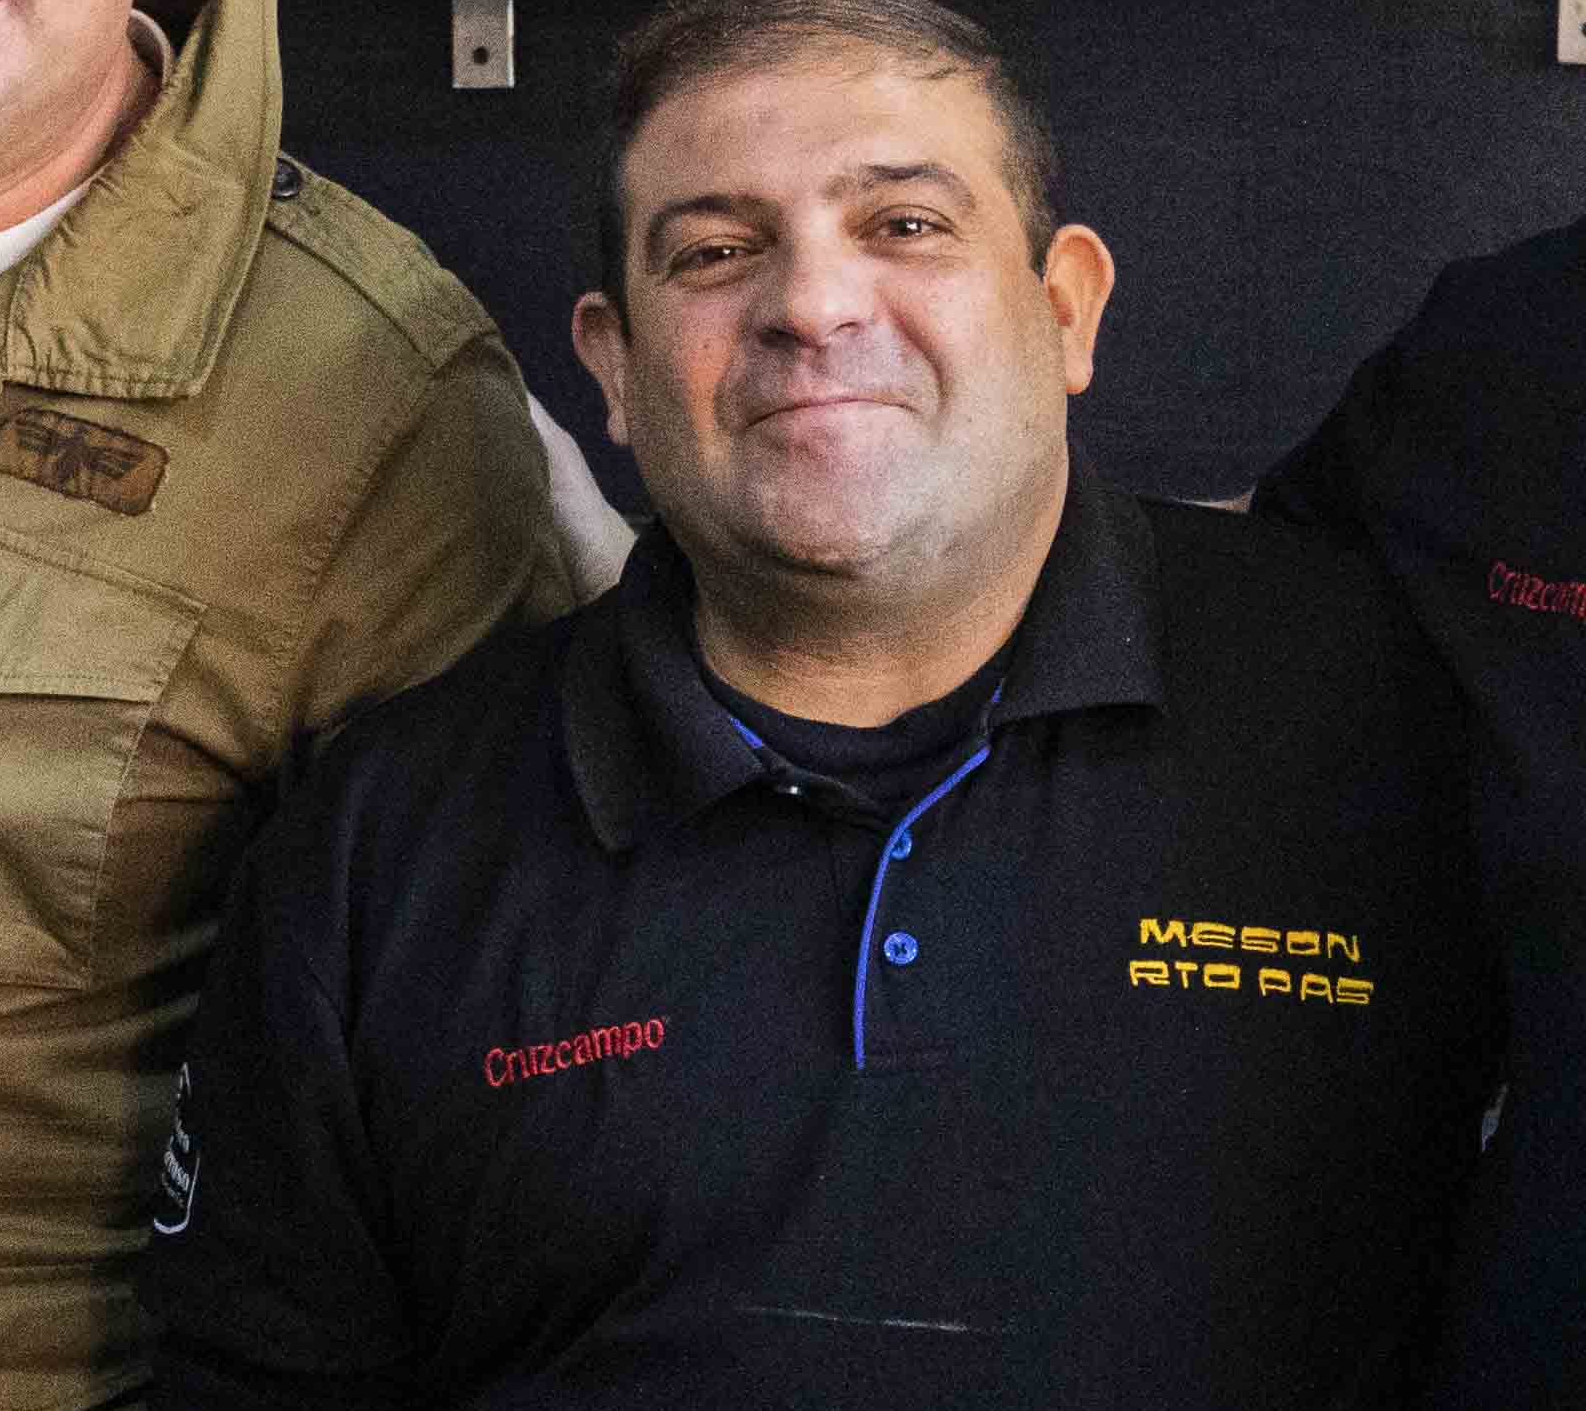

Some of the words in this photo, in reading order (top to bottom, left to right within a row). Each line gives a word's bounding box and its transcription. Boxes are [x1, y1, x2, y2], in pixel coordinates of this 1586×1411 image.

[1138, 916, 1361, 964] MESON
[1127, 958, 1242, 990] RTO
[1258, 967, 1375, 1006] PAS
[482, 1014, 668, 1089] Cruzcampo
